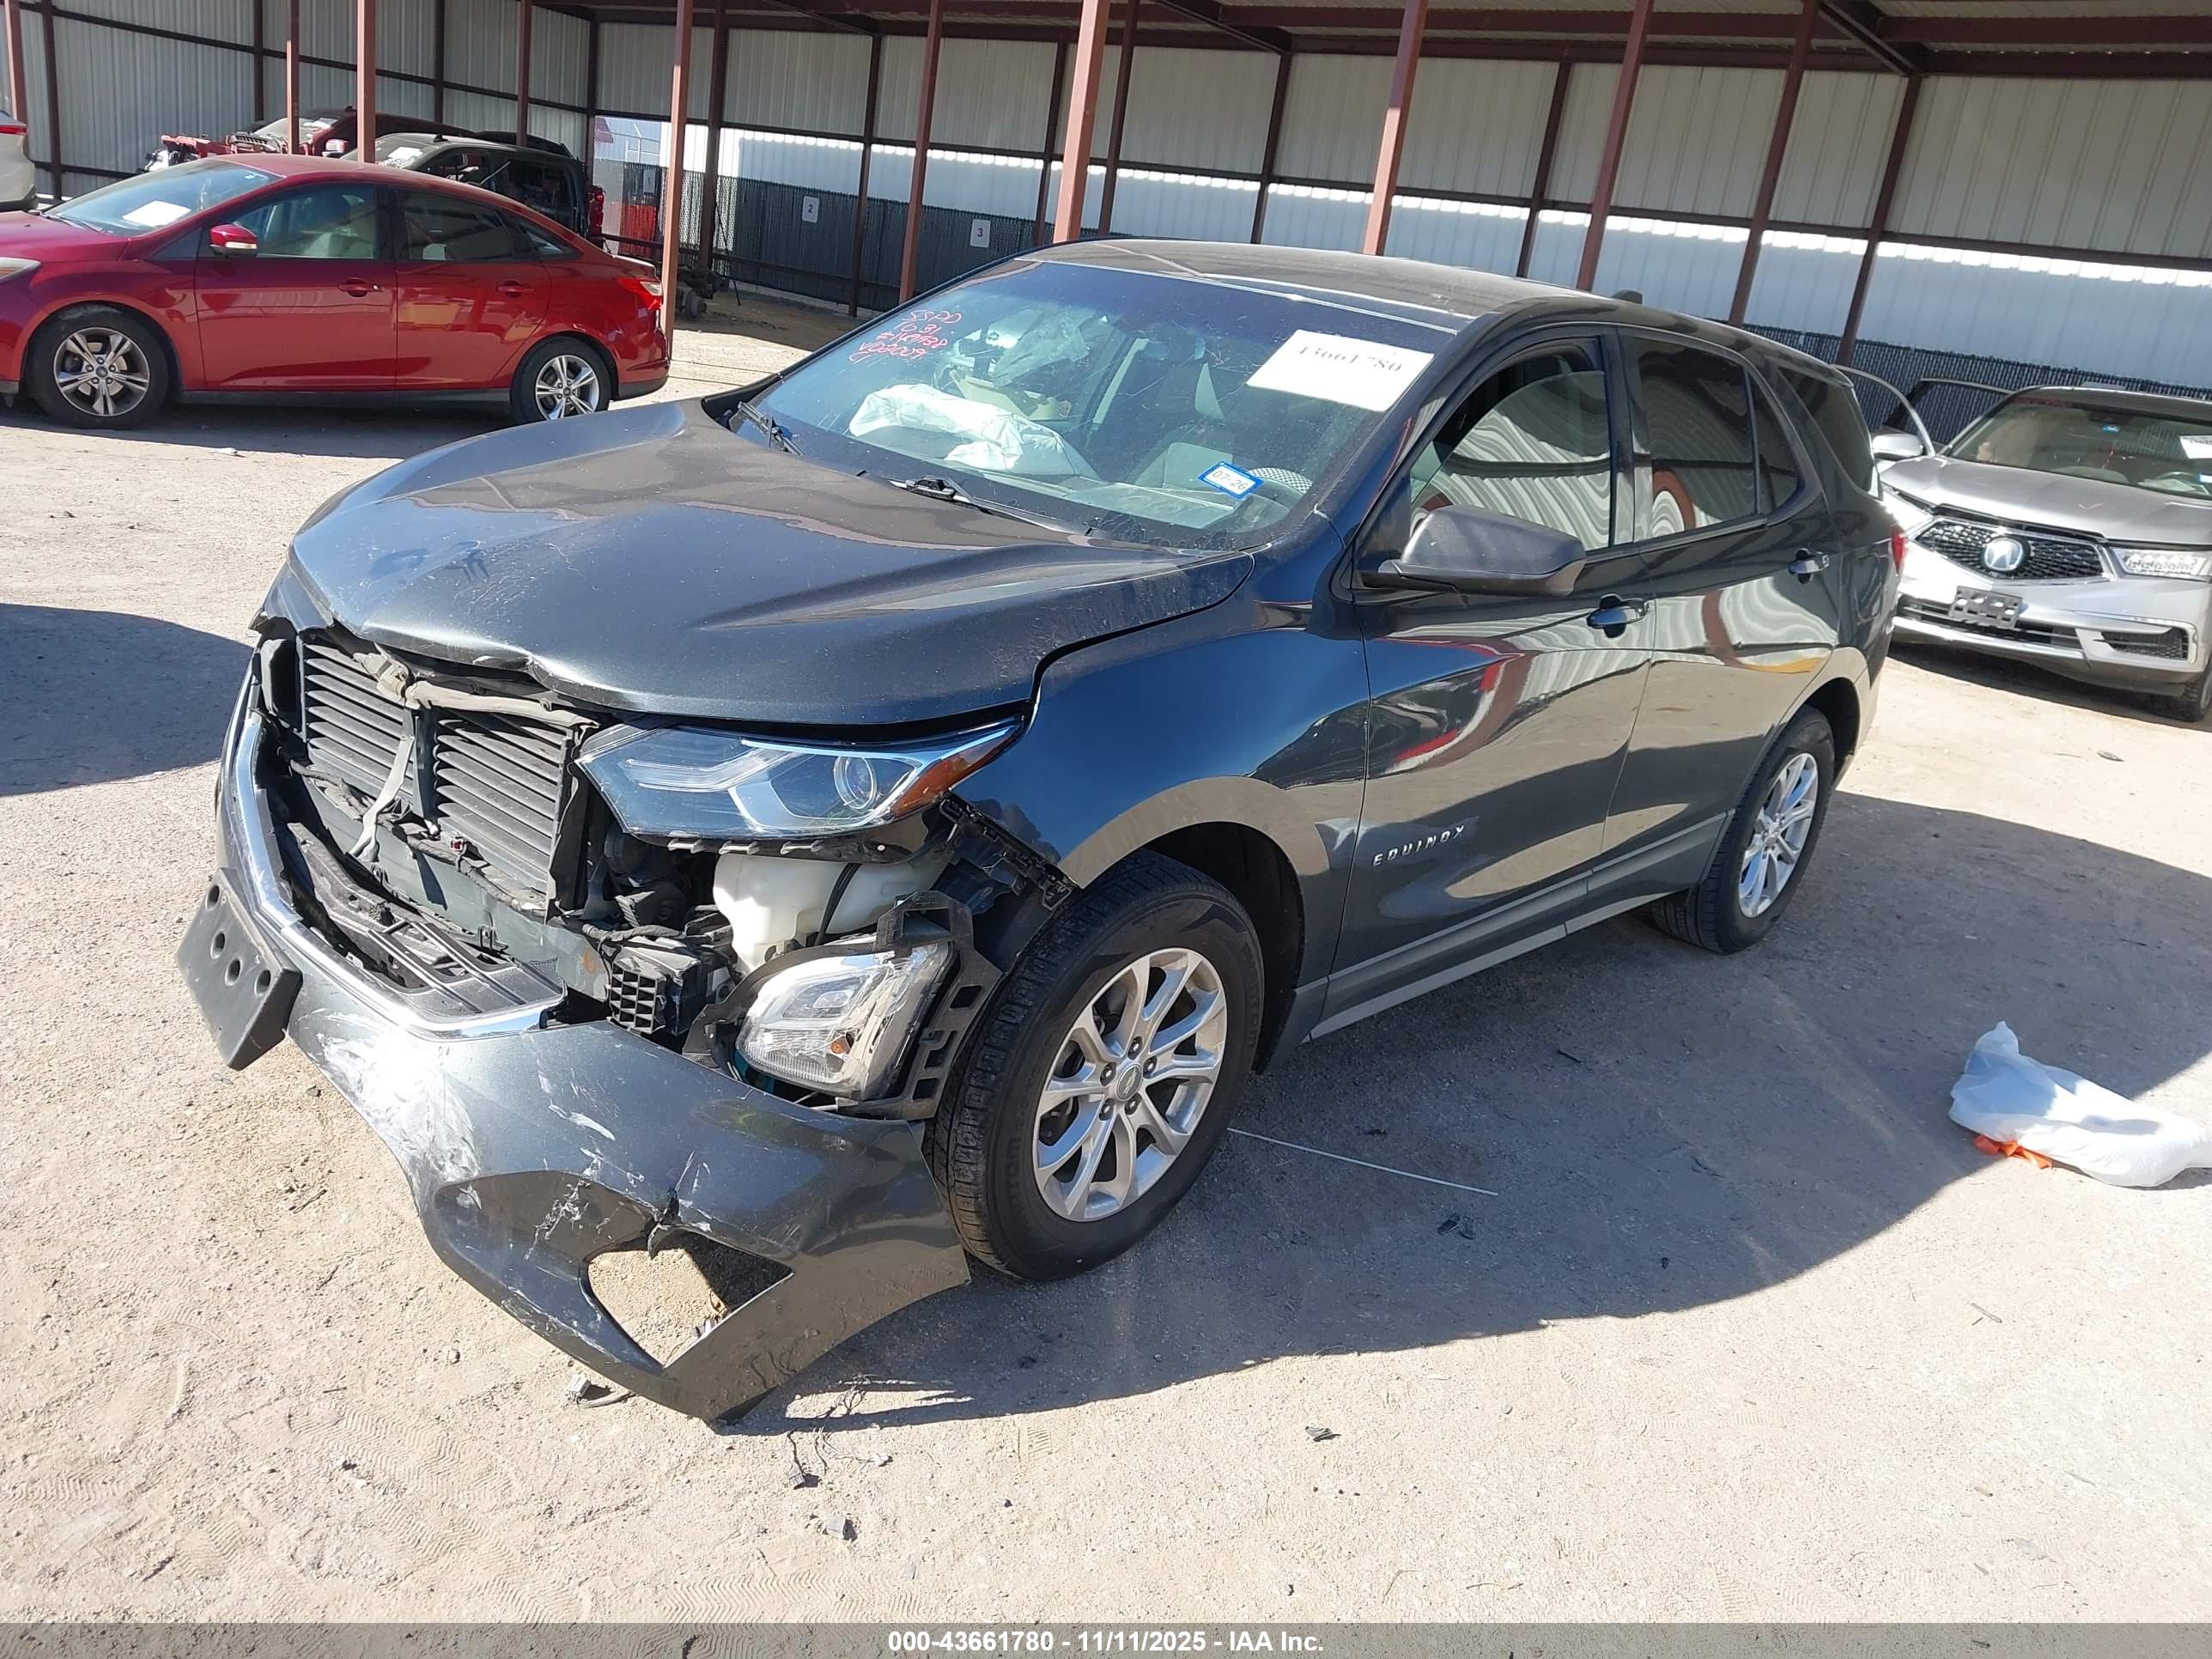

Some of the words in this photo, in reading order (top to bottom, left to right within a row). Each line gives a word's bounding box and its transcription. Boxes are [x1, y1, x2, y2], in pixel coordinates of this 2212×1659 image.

[807, 204, 813, 214] 2
[977, 228, 983, 238] 3
[1372, 824, 1465, 866] EQUINOX
